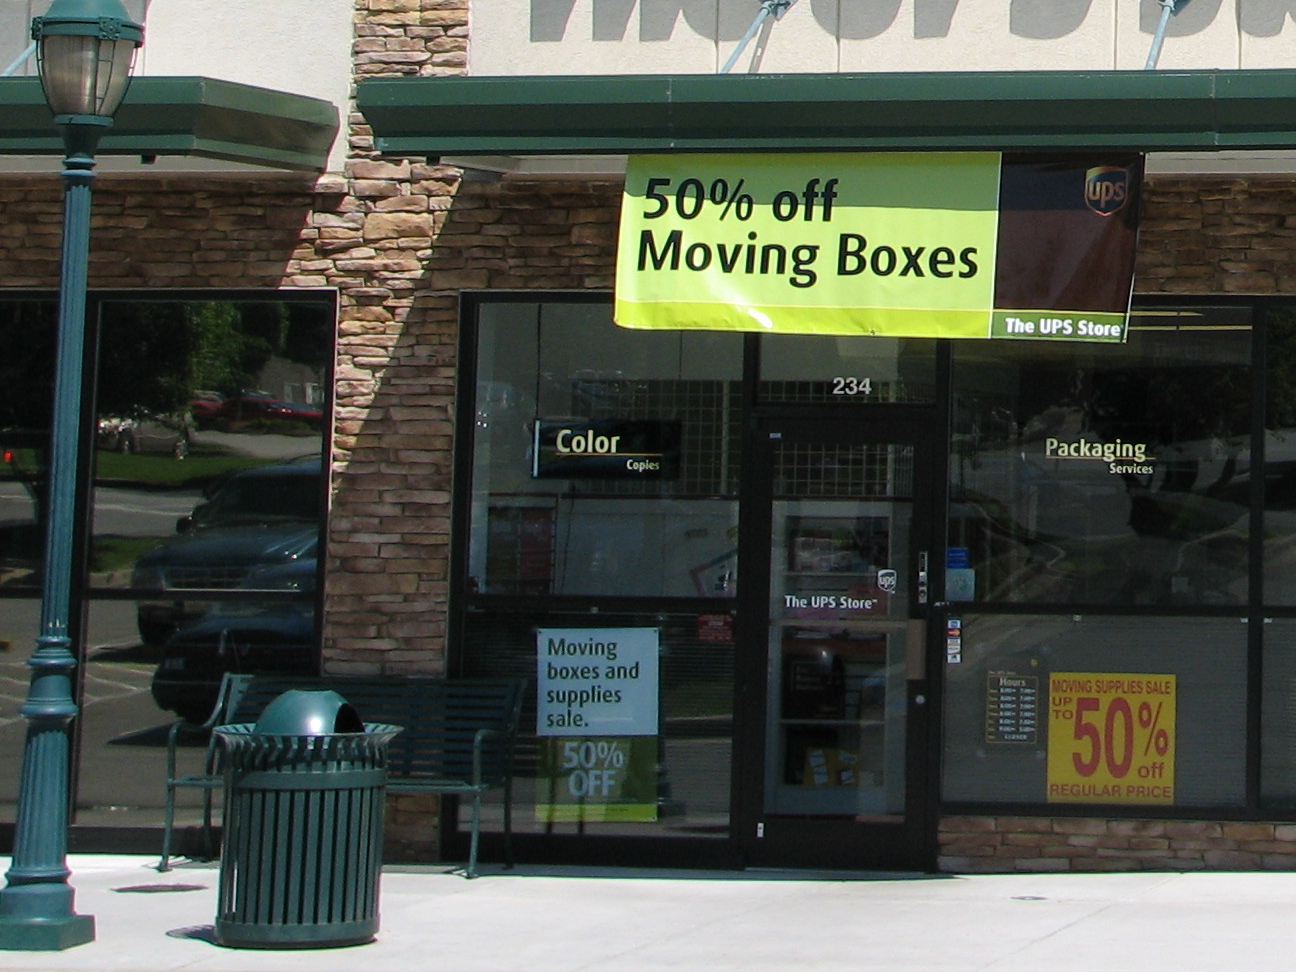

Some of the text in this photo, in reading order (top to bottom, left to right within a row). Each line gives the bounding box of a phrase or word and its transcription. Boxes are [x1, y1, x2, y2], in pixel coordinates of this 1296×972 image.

[643, 178, 839, 222] 50% off
[637, 229, 979, 289] Moving Boxes
[1005, 317, 1122, 337] The UPS Store
[832, 376, 873, 395] 234
[556, 429, 620, 454] Color
[1045, 438, 1147, 463] Packaging
[626, 459, 660, 472] Copies
[1109, 462, 1154, 474] Services
[785, 595, 807, 608] The
[811, 596, 836, 609] UPS
[548, 637, 618, 660] Moving
[547, 661, 639, 680] boxes and
[1051, 678, 1171, 695] MOVING SUPPLIES SALE
[547, 685, 622, 708] supplies
[1052, 697, 1072, 707] UP
[547, 709, 589, 728] sale.
[1053, 709, 1074, 720] TO
[1072, 697, 1169, 779] 50%
[563, 741, 624, 769] 50%
[1137, 761, 1165, 778] off
[568, 770, 616, 797] OFF
[1050, 784, 1172, 799] REGULAR PRICE
